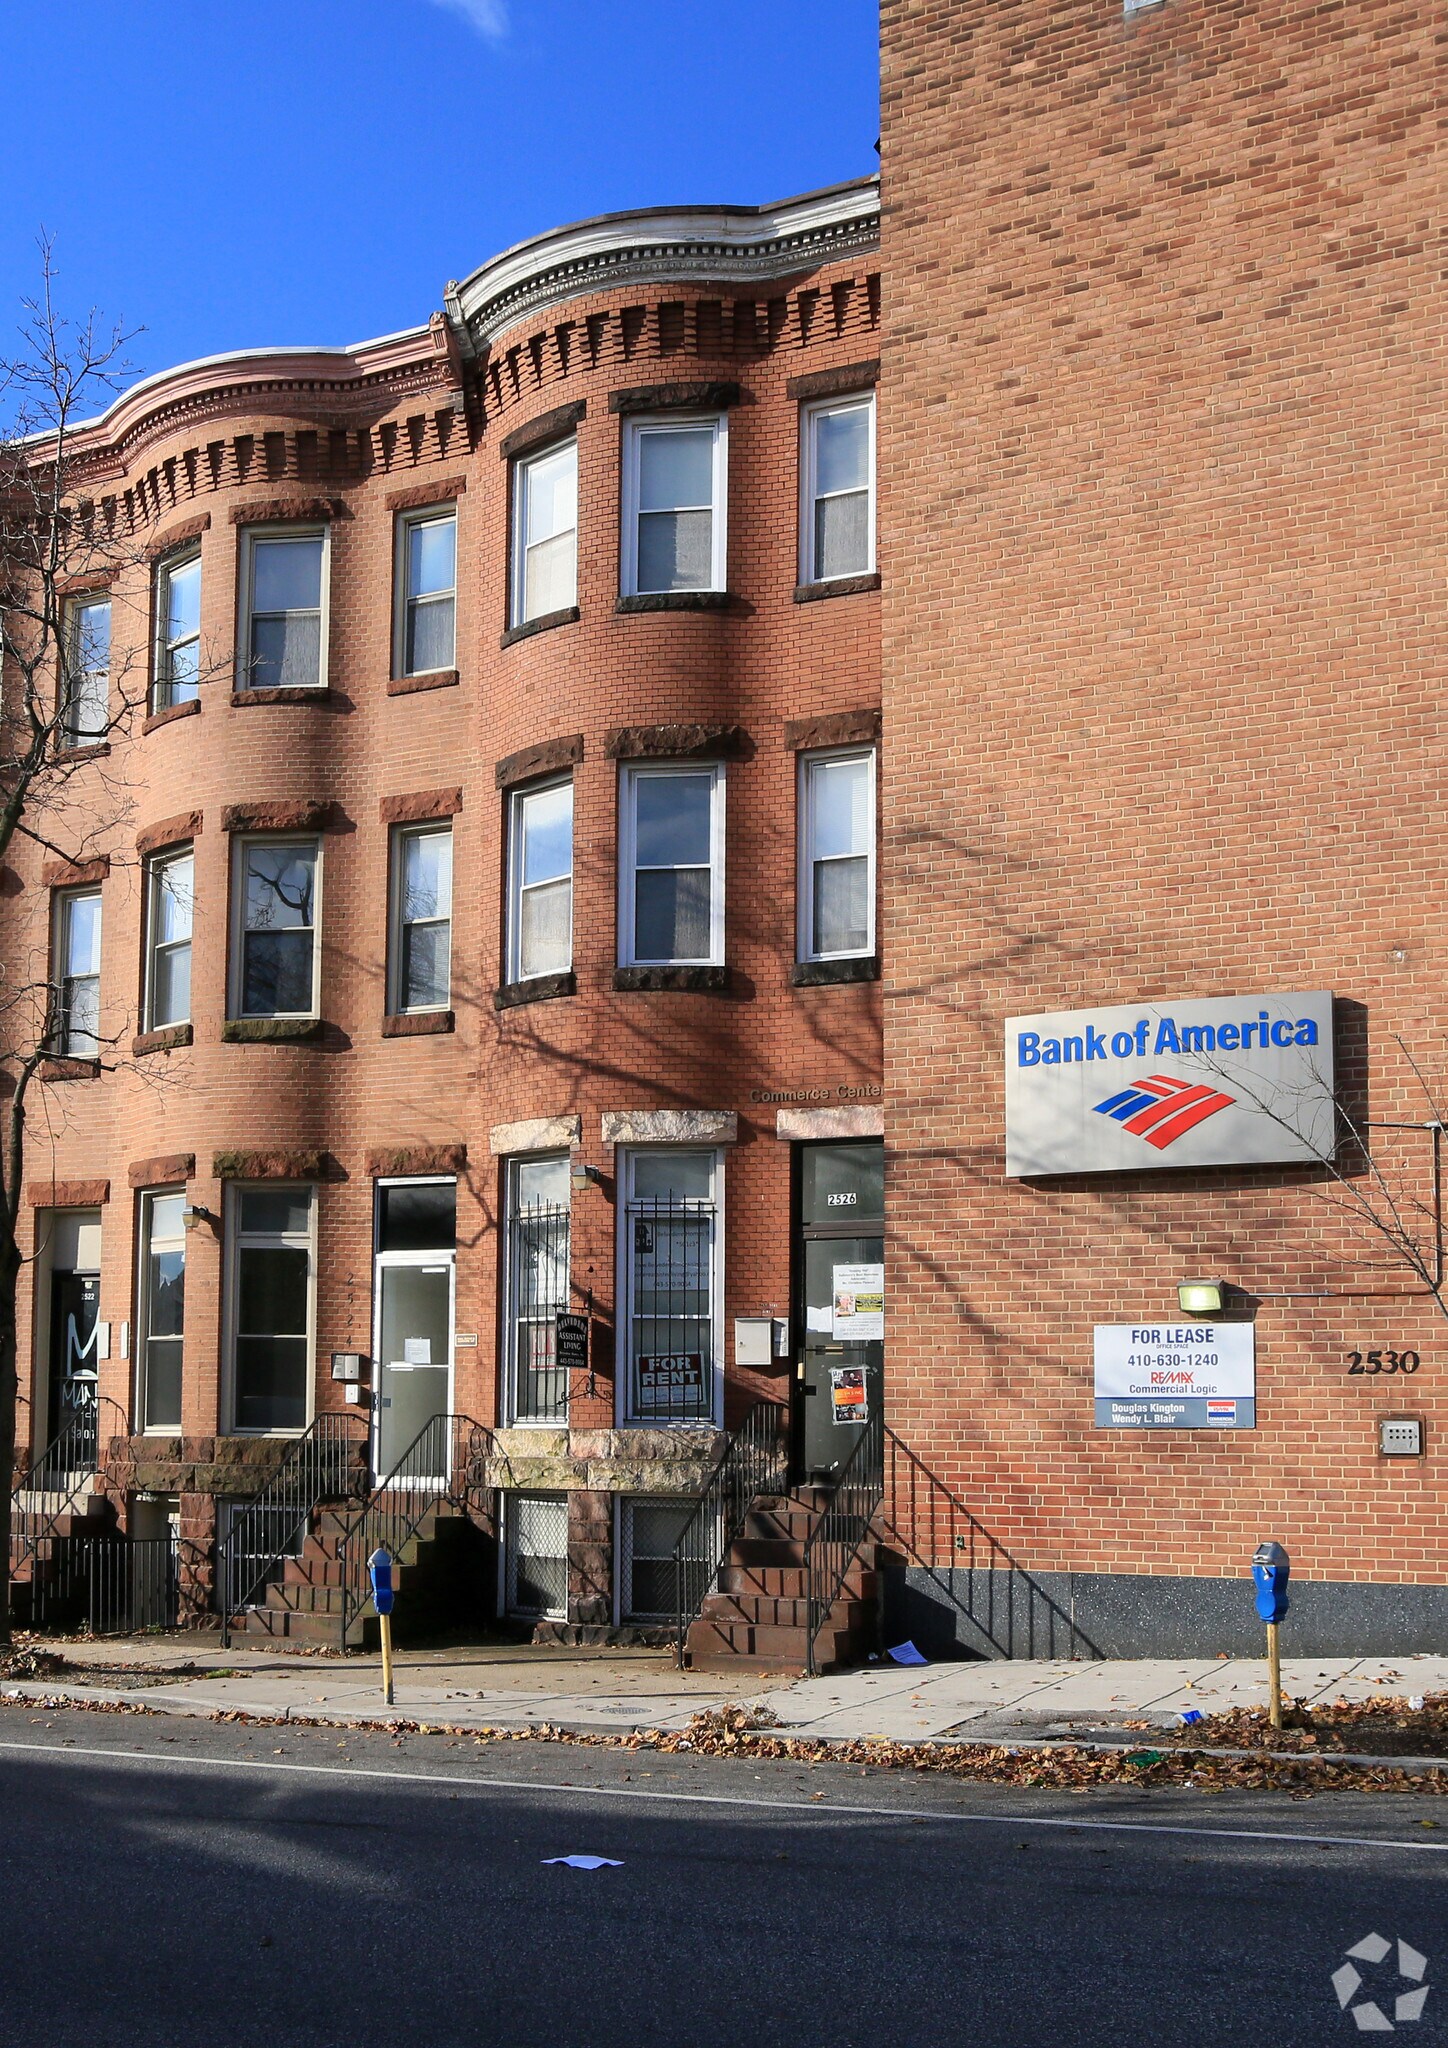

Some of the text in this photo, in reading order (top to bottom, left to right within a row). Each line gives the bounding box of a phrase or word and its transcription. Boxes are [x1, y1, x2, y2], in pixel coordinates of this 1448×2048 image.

[1018, 1011, 1319, 1067] Bank of America
[750, 1089, 830, 1102] Commerce
[829, 1193, 855, 1205] 2526
[559, 1332, 586, 1342] ASSISTANT
[1131, 1328, 1214, 1344] FOR LEASE
[563, 1341, 581, 1350] LIVING
[648, 1357, 691, 1371] FOR
[1128, 1353, 1219, 1366] 410-630-1240
[1347, 1350, 1420, 1375] 2530
[642, 1370, 698, 1386] RENT
[1151, 1371, 1194, 1384] RE/MAX
[1129, 1384, 1218, 1395] Commercial Logic
[1112, 1403, 1185, 1414] Douglas Kington
[1112, 1413, 1176, 1425] Wendy L. Blair
